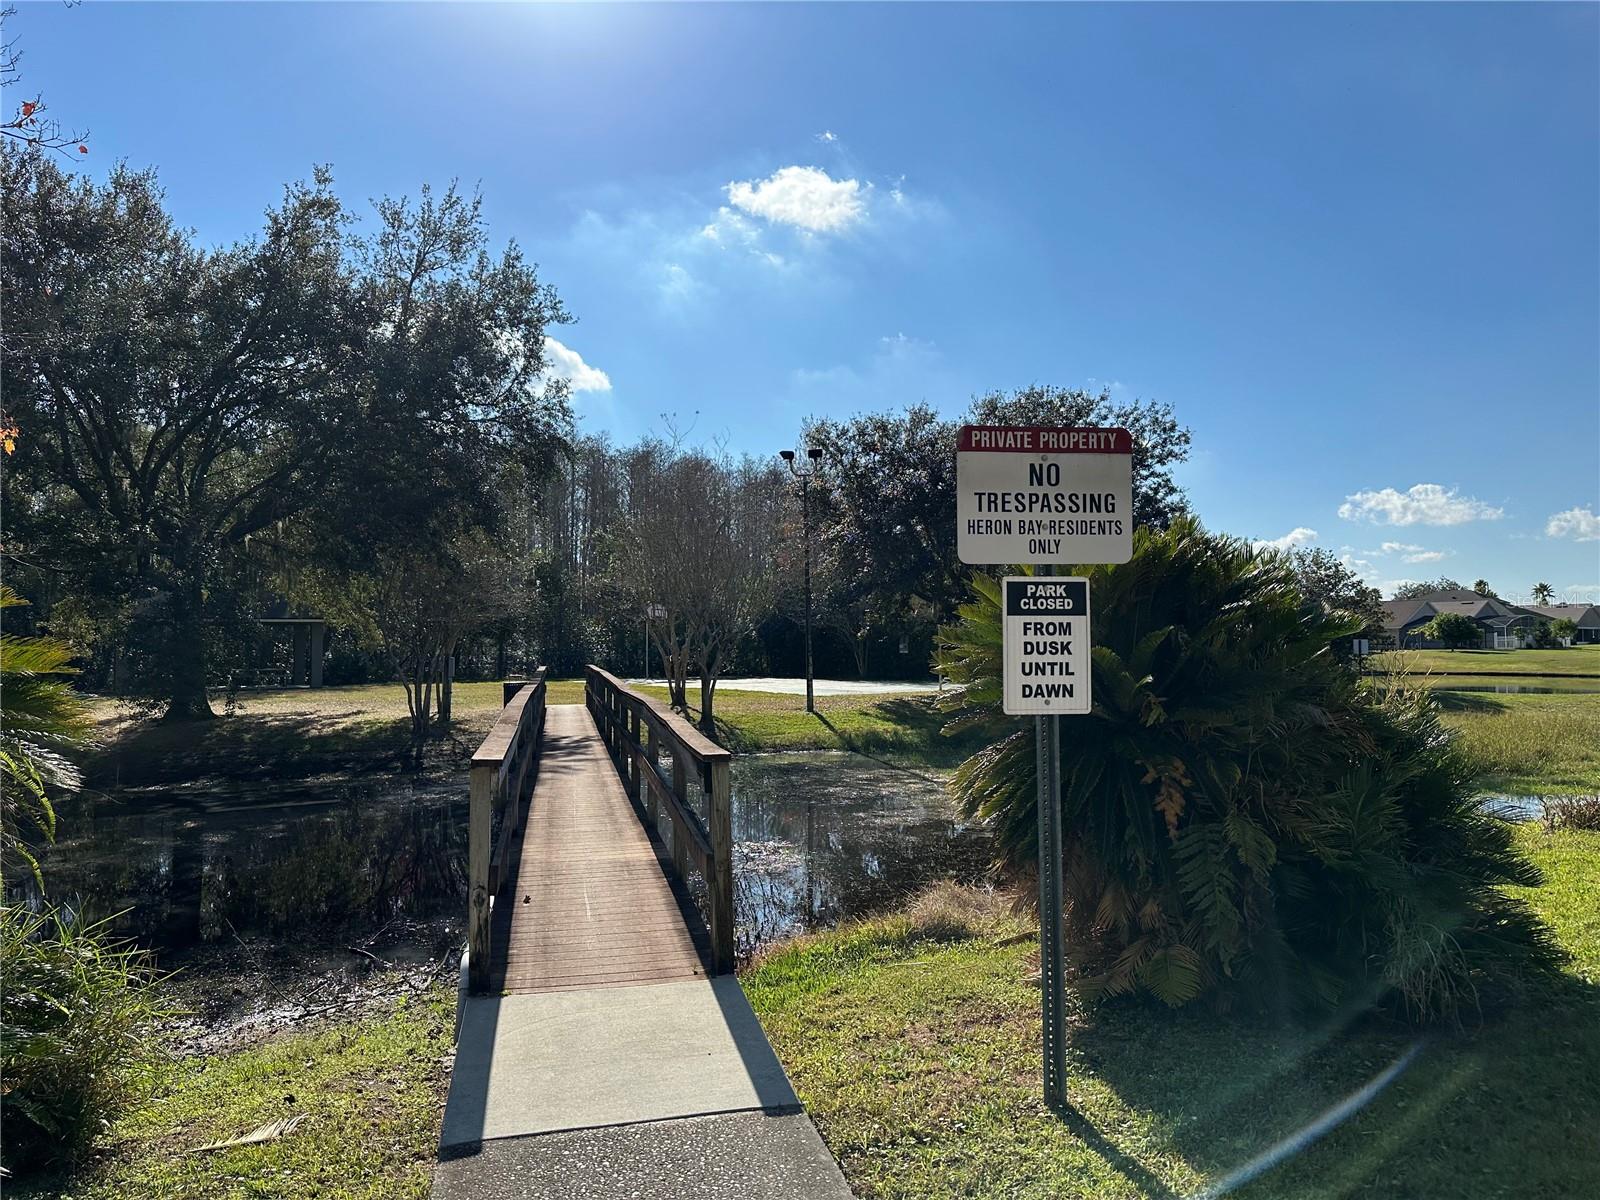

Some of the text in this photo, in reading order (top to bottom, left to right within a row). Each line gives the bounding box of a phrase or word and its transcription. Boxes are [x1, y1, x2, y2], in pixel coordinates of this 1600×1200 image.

[971, 430, 1117, 449] PRIVATE PROPERTY
[1029, 463, 1061, 487] NO
[973, 492, 1116, 514] TRESPASSING
[967, 519, 1123, 536] HERON BAY RESIDENTS
[1028, 538, 1061, 555] ONLY
[1026, 584, 1067, 597] PARK
[1020, 598, 1073, 610] CLOSED
[1023, 621, 1072, 636] FROM
[1023, 641, 1072, 655] DUSK
[1021, 661, 1075, 676] UNTIL
[1022, 683, 1074, 698] DAWN
